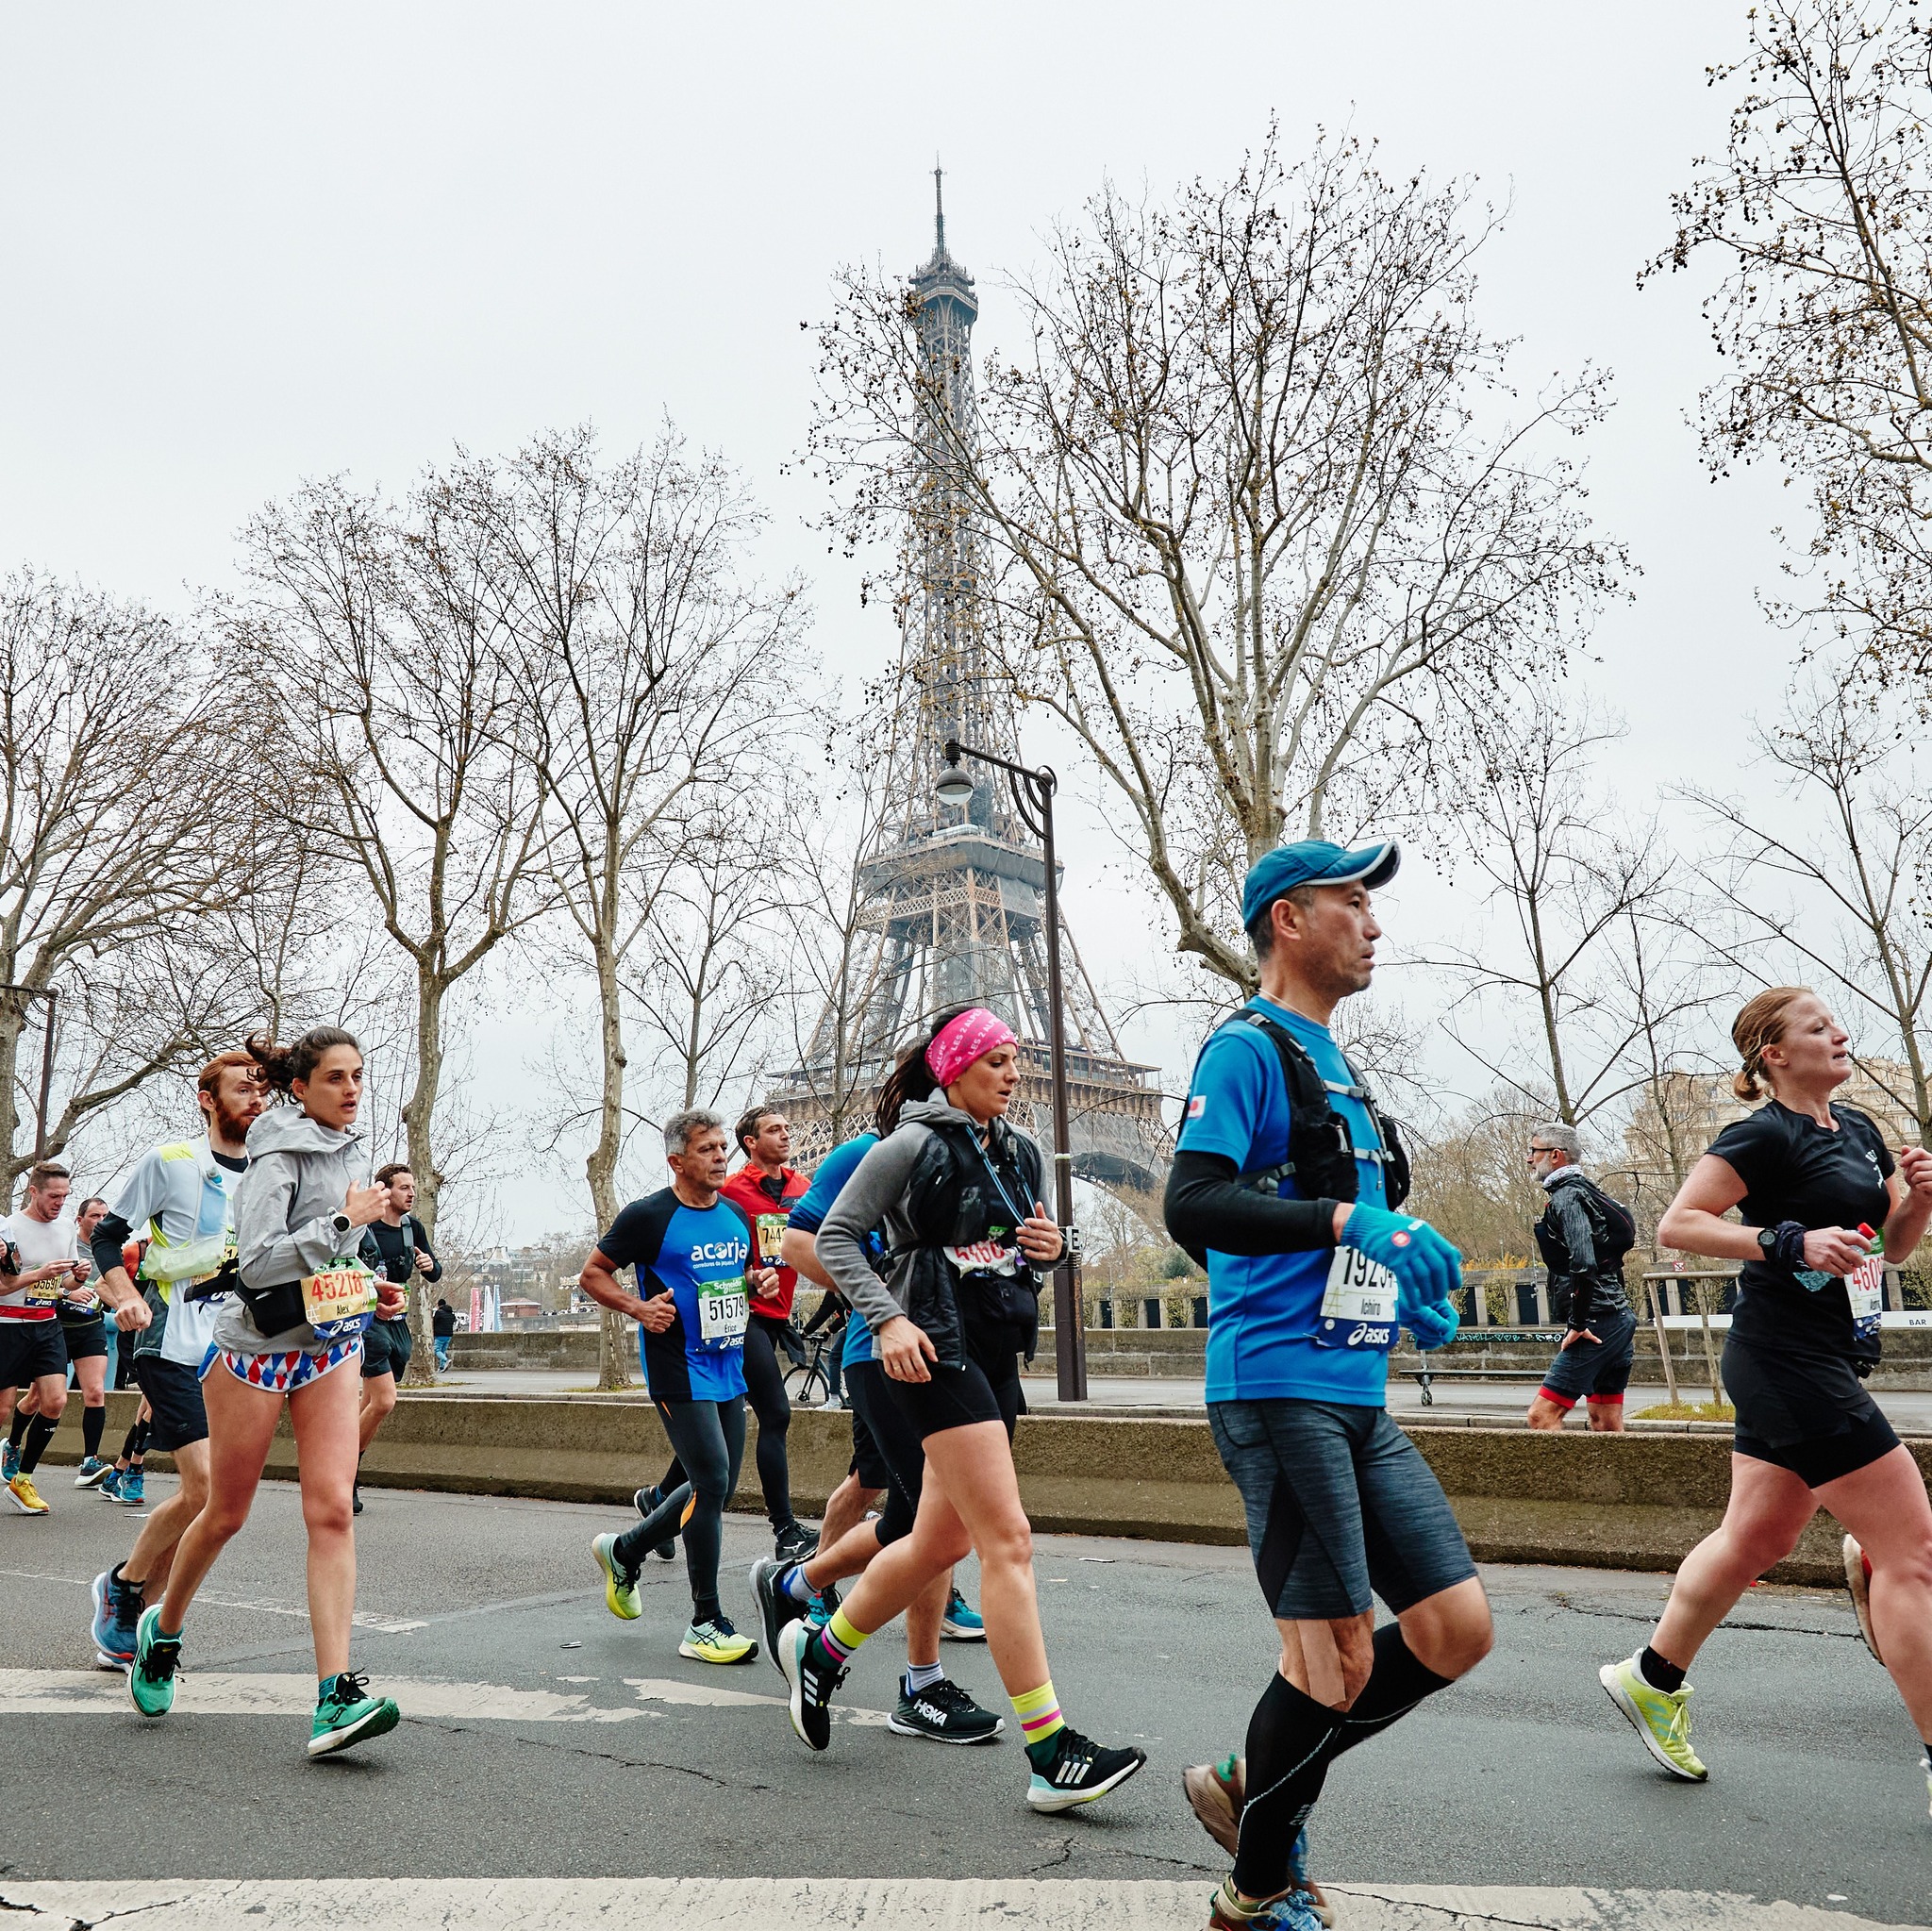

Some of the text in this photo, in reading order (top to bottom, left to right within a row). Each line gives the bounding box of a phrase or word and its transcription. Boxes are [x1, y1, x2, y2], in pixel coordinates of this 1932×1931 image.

[951, 1034, 963, 1051] LES
[968, 1039, 981, 1056] LES
[337, 1305, 350, 1316] Alex
[709, 1295, 743, 1322] 51579
[1361, 1298, 1381, 1316] Ichiro
[913, 1698, 948, 1727] HOKA
